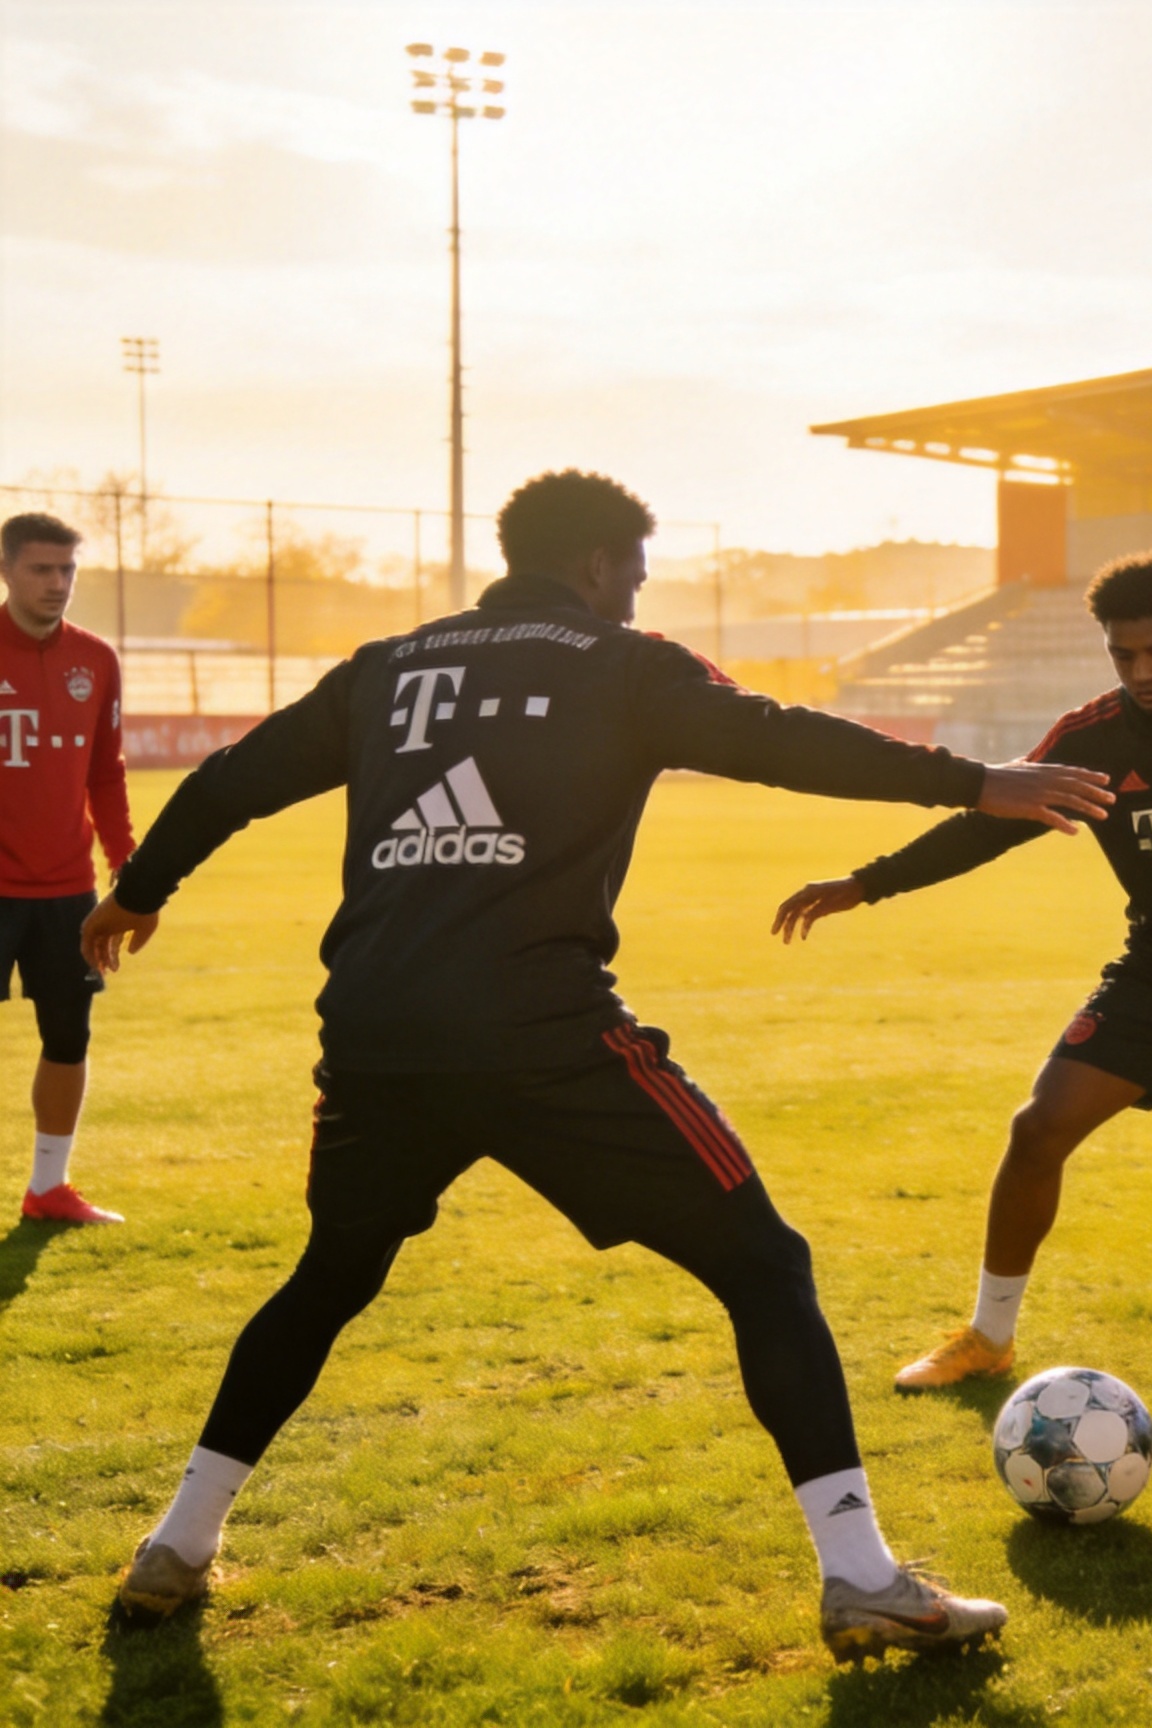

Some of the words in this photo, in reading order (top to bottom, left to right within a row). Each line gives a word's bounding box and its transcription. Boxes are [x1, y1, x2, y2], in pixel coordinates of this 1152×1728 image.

[0, 709, 39, 767] T
[395, 666, 466, 753] T
[371, 825, 526, 869] adidas
